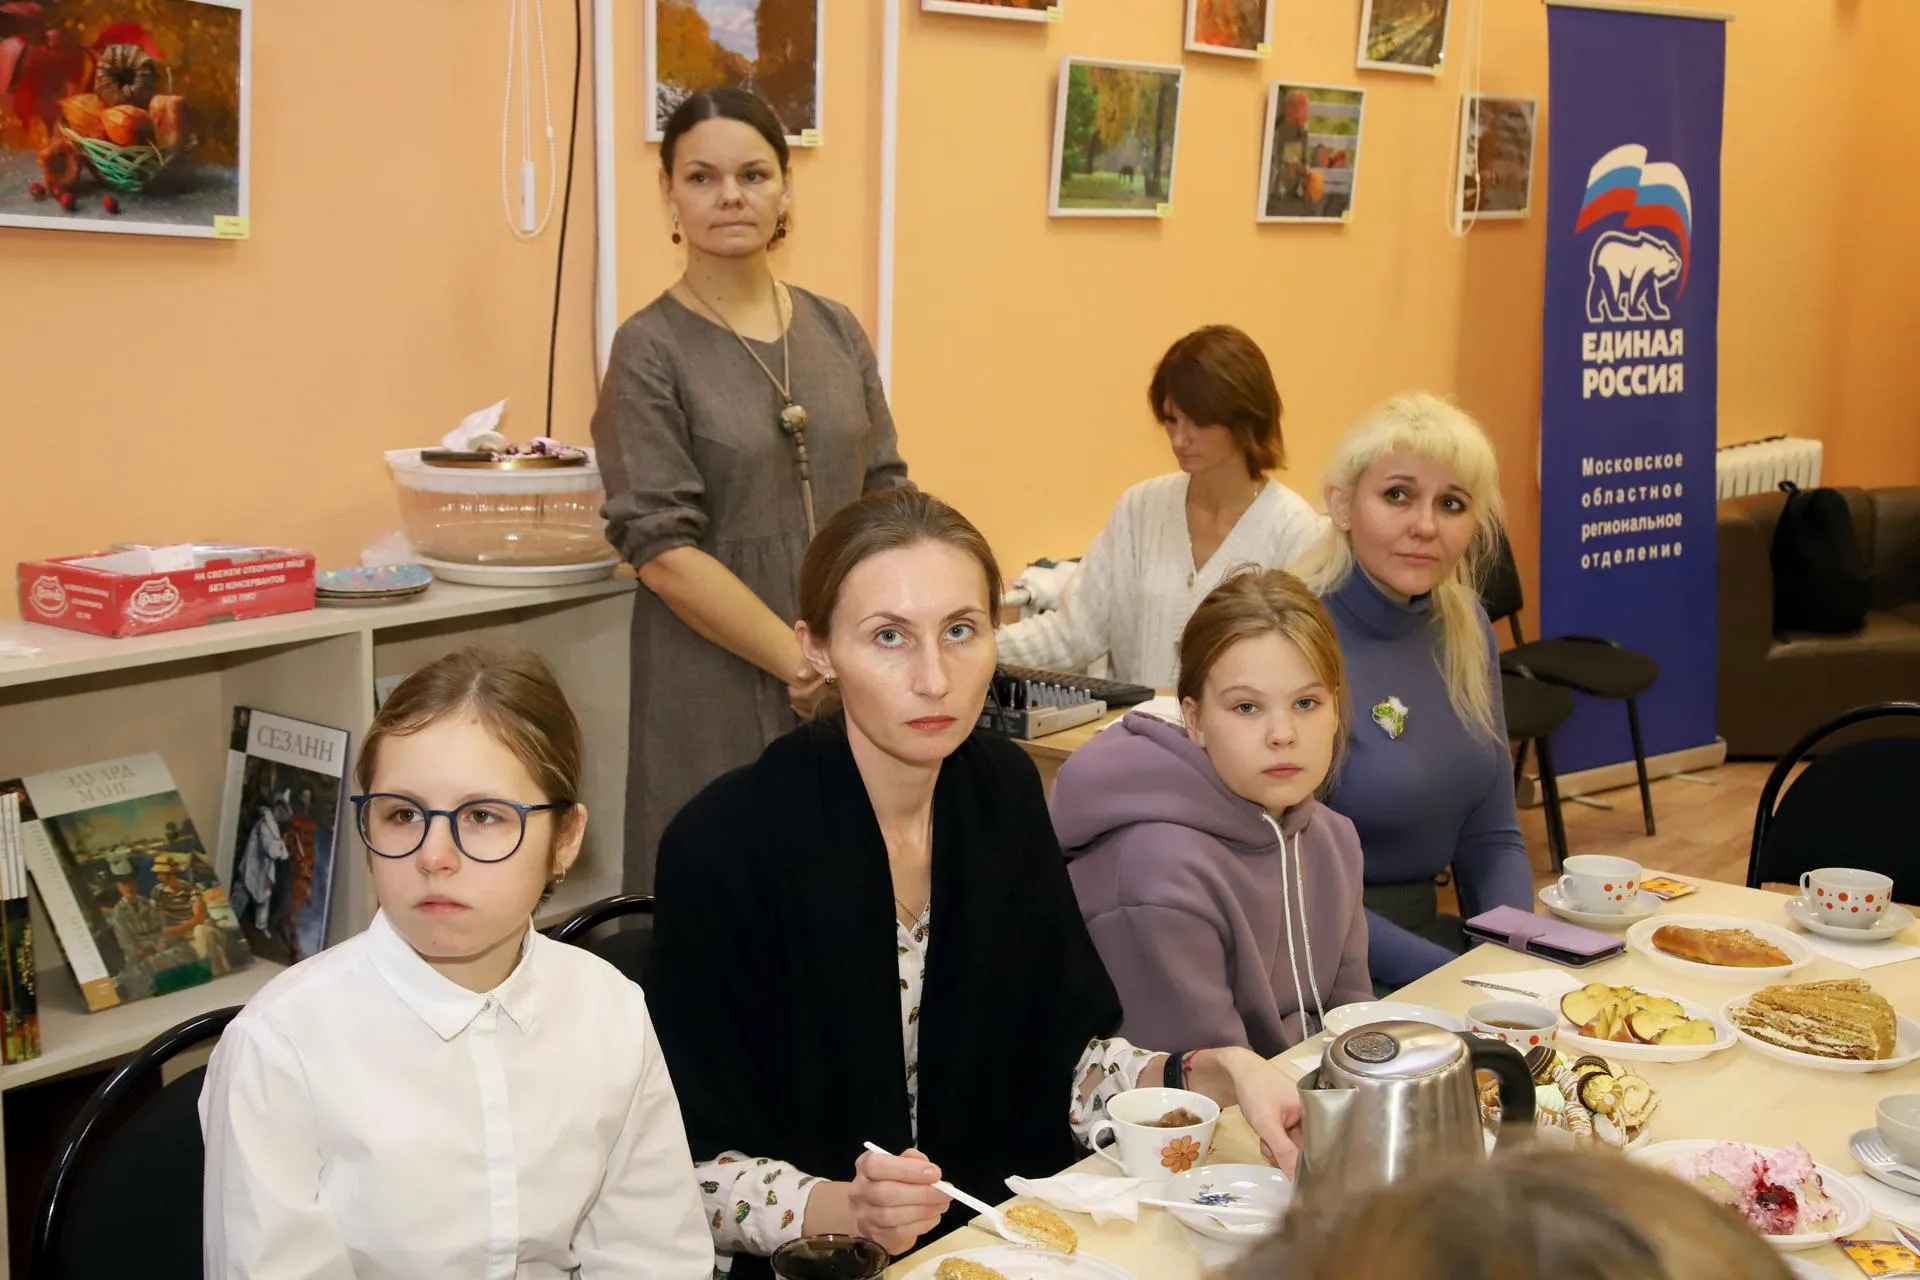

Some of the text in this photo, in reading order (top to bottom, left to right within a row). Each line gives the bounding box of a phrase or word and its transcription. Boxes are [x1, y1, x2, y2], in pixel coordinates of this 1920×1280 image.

[1582, 328, 1684, 363] ЕДИНАЯ
[1582, 363, 1684, 399] РОССИЯ
[1581, 452, 1684, 477] Московское
[1581, 482, 1684, 508] областное
[1581, 512, 1683, 542] региональное
[1581, 542, 1683, 570] отделение
[256, 724, 335, 763] СЕЗАНН
